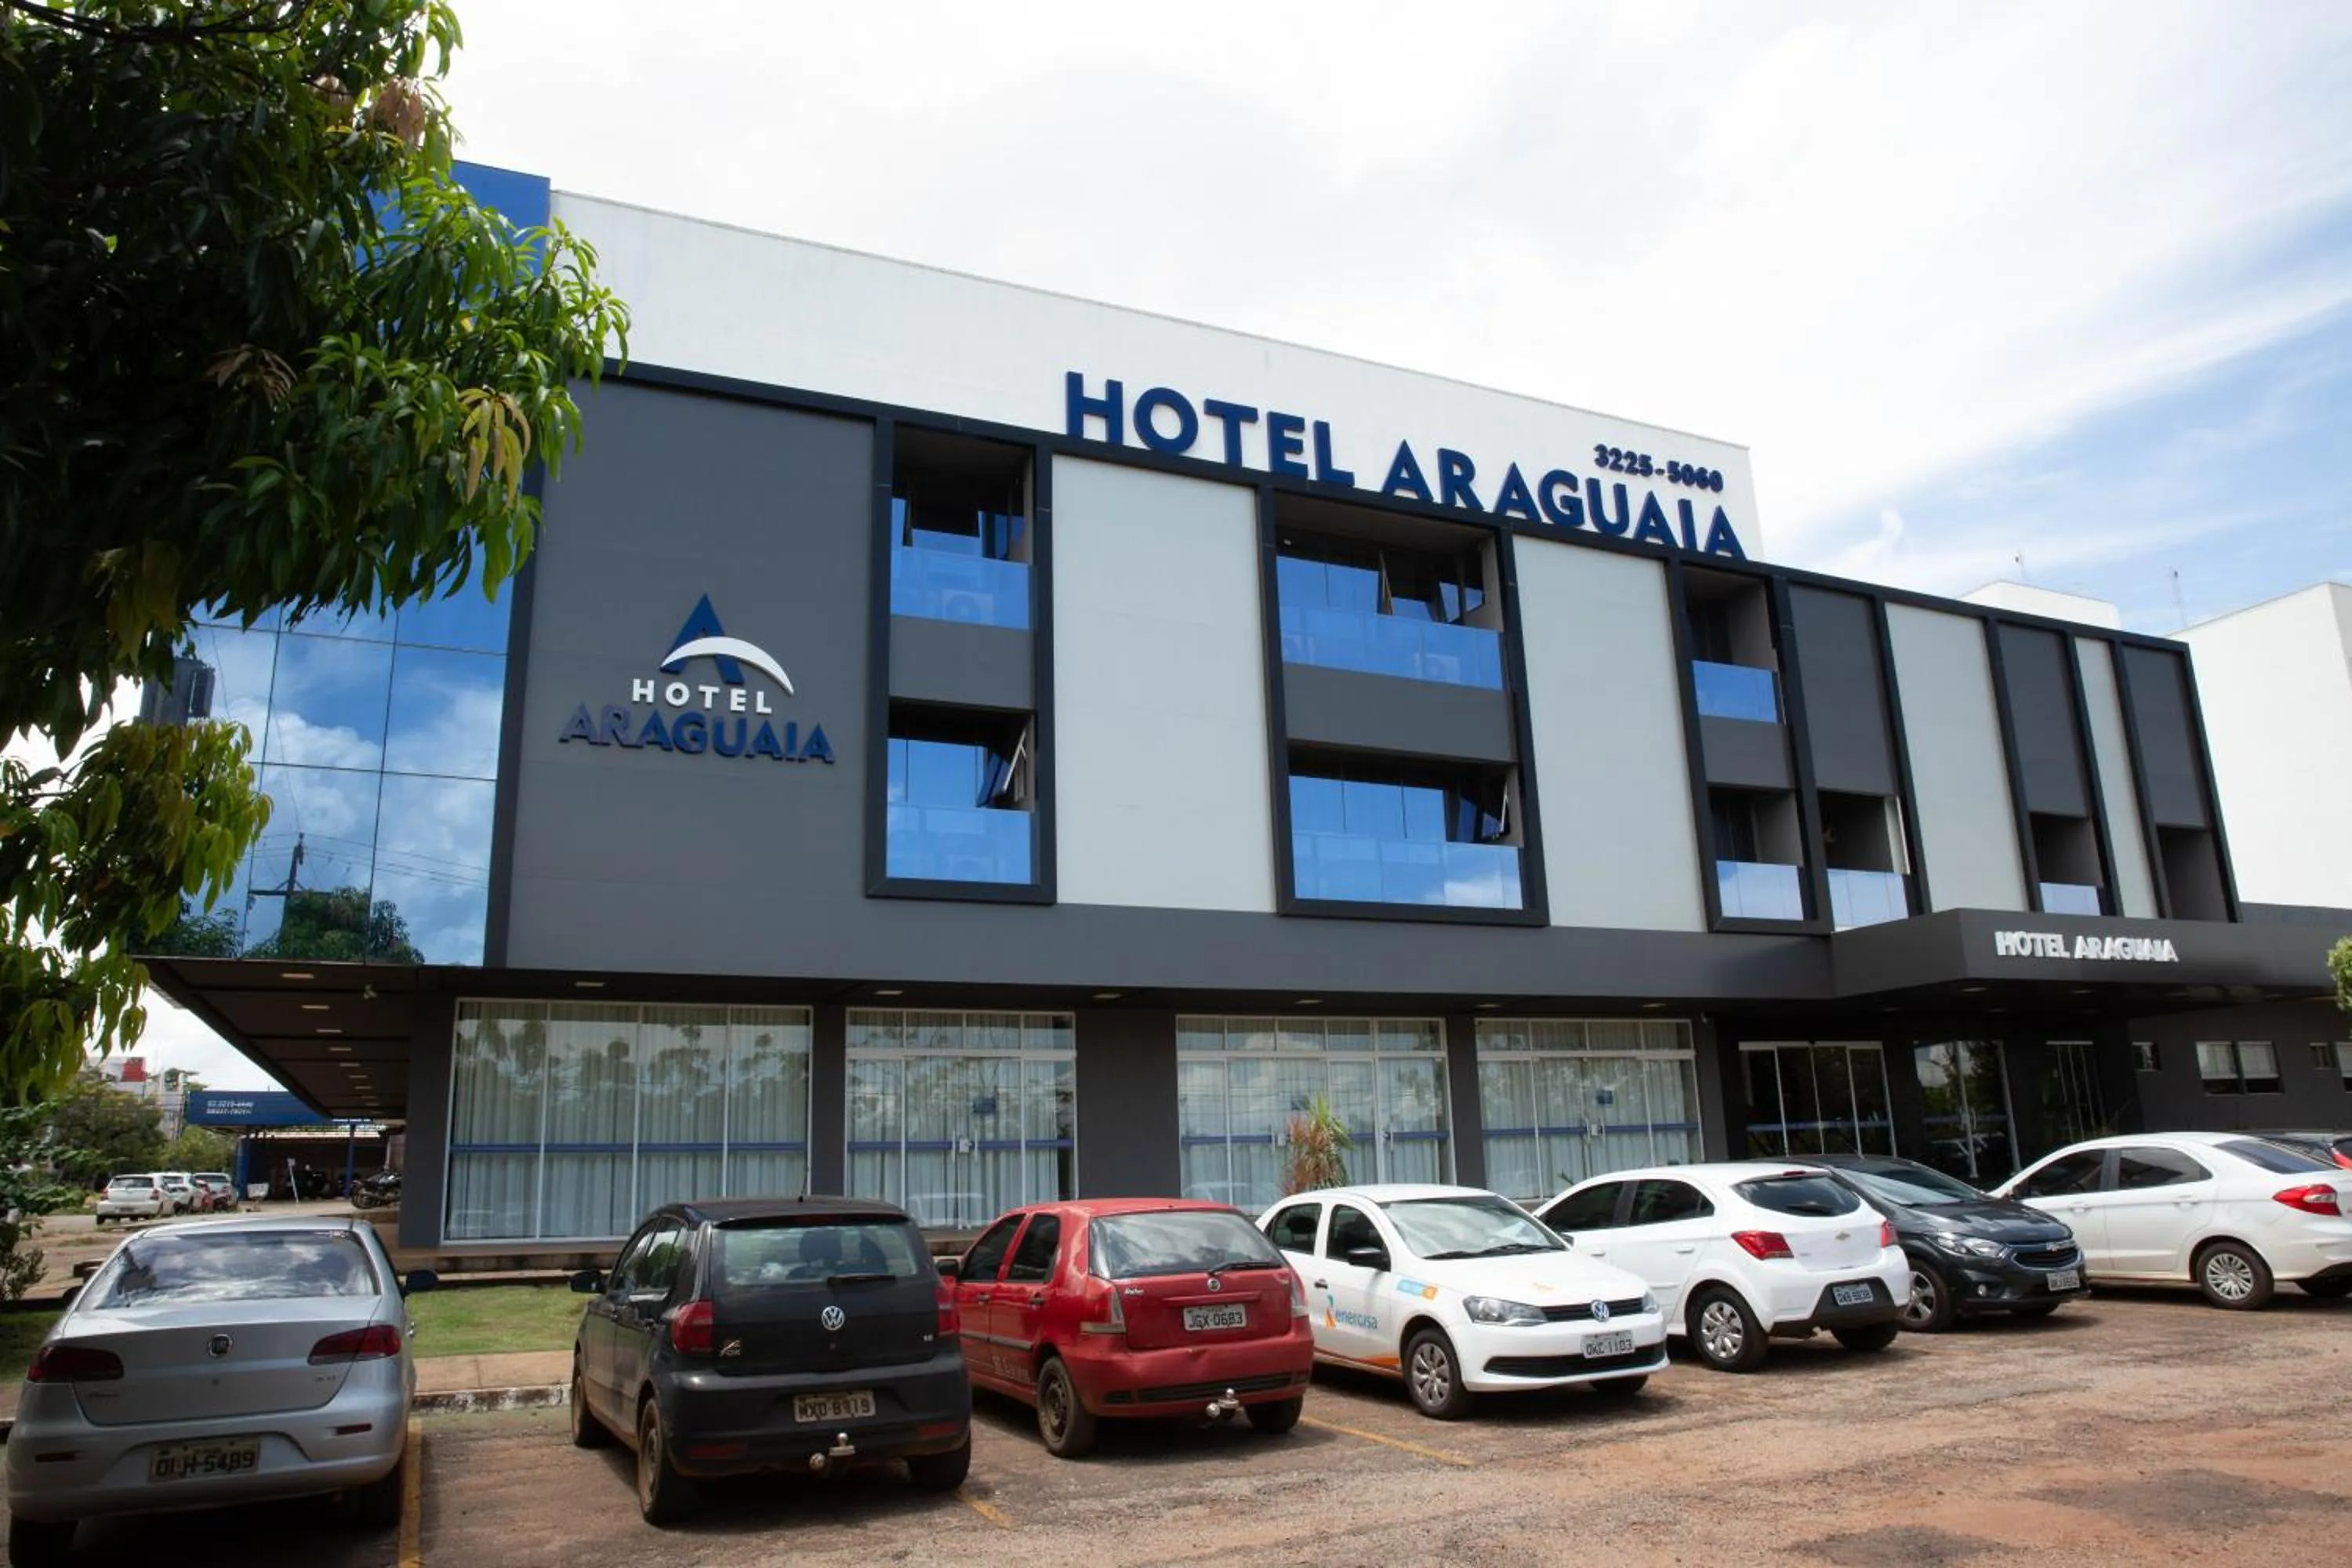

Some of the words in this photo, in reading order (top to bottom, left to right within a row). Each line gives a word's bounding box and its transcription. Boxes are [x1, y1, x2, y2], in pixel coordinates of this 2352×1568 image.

[1065, 371, 1355, 488] HOTEL
[1380, 438, 1748, 561] ARAGUAIA
[1592, 443, 1724, 494] 3225-5060
[631, 678, 773, 715] HOTEL
[557, 702, 837, 765] ARAGUAIA
[1994, 931, 2071, 959] HOTEL
[2074, 935, 2180, 963] ARAGUAIA
